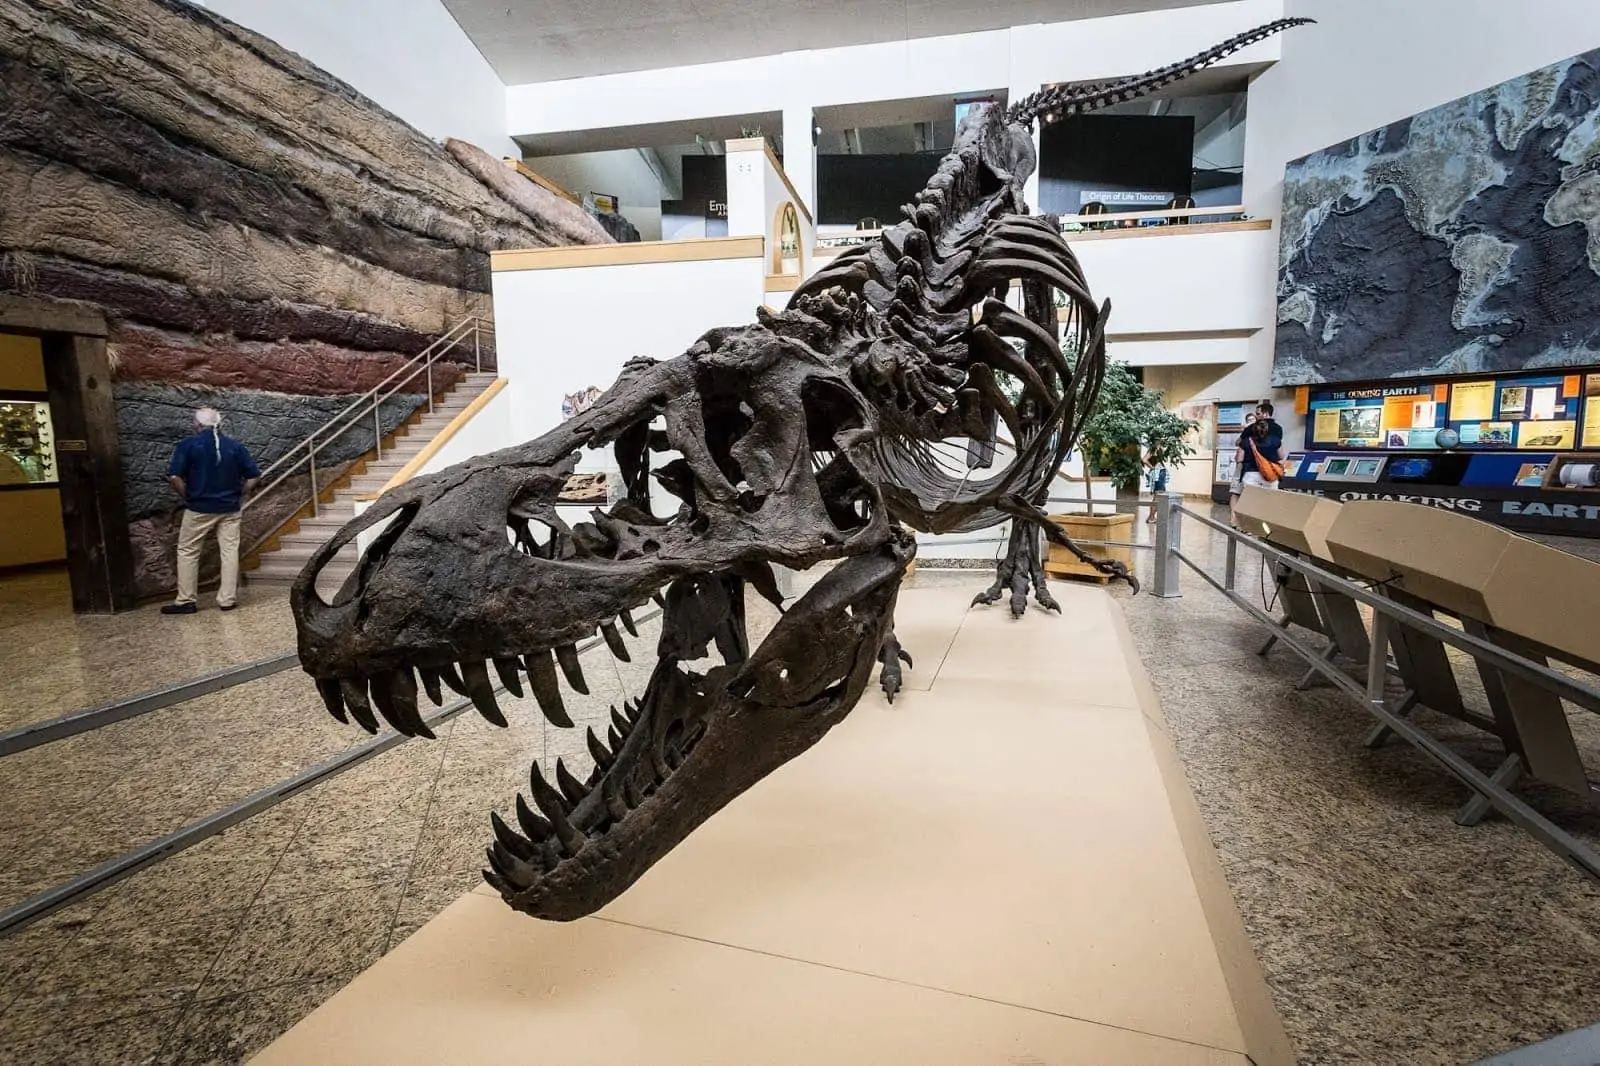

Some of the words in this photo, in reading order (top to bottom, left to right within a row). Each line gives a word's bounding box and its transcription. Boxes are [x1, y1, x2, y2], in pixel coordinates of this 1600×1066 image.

[1113, 191, 1121, 201] of
[1122, 192, 1134, 201] Life
[1135, 192, 1165, 201] Theories
[1333, 391, 1346, 400] THE
[1382, 387, 1417, 396] EARTH
